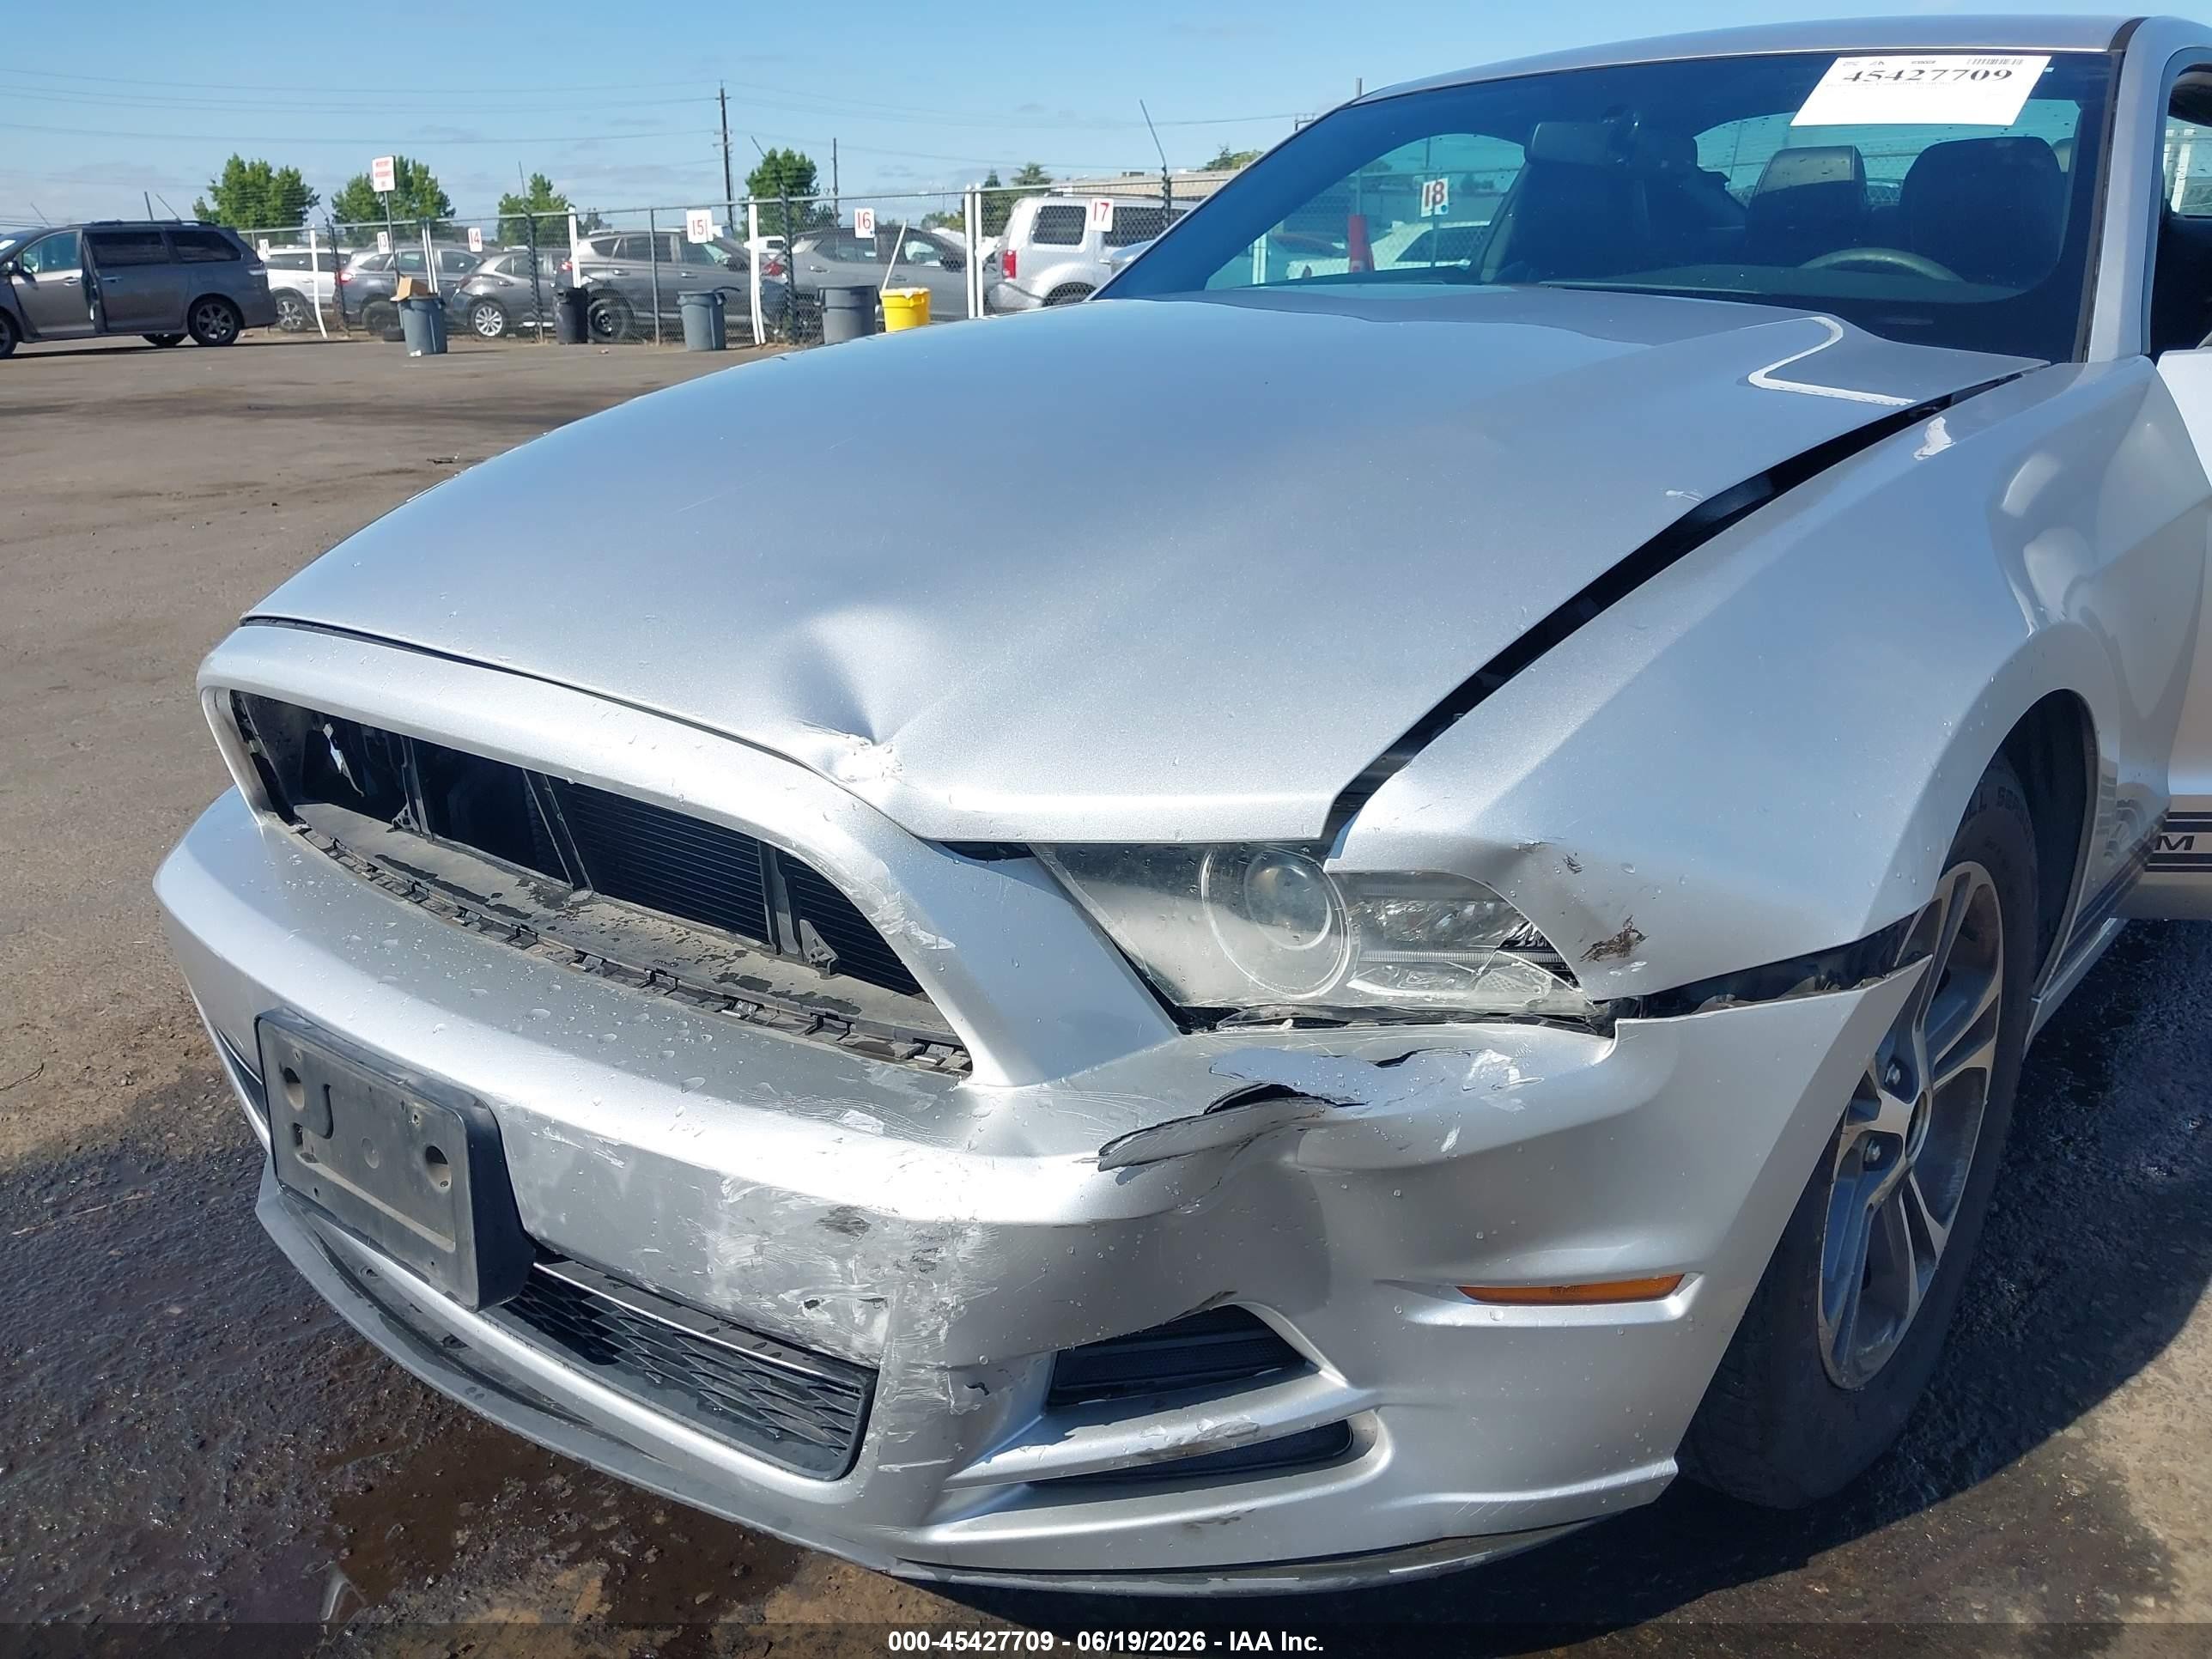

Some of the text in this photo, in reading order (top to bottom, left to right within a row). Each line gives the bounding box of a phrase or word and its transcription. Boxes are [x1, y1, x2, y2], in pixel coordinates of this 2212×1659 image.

[1843, 69, 2013, 82] 45427709
[1424, 181, 1444, 207] 18
[857, 211, 872, 229] 16
[1093, 202, 1109, 222] 17
[379, 234, 387, 248] 13
[470, 230, 480, 245] 14
